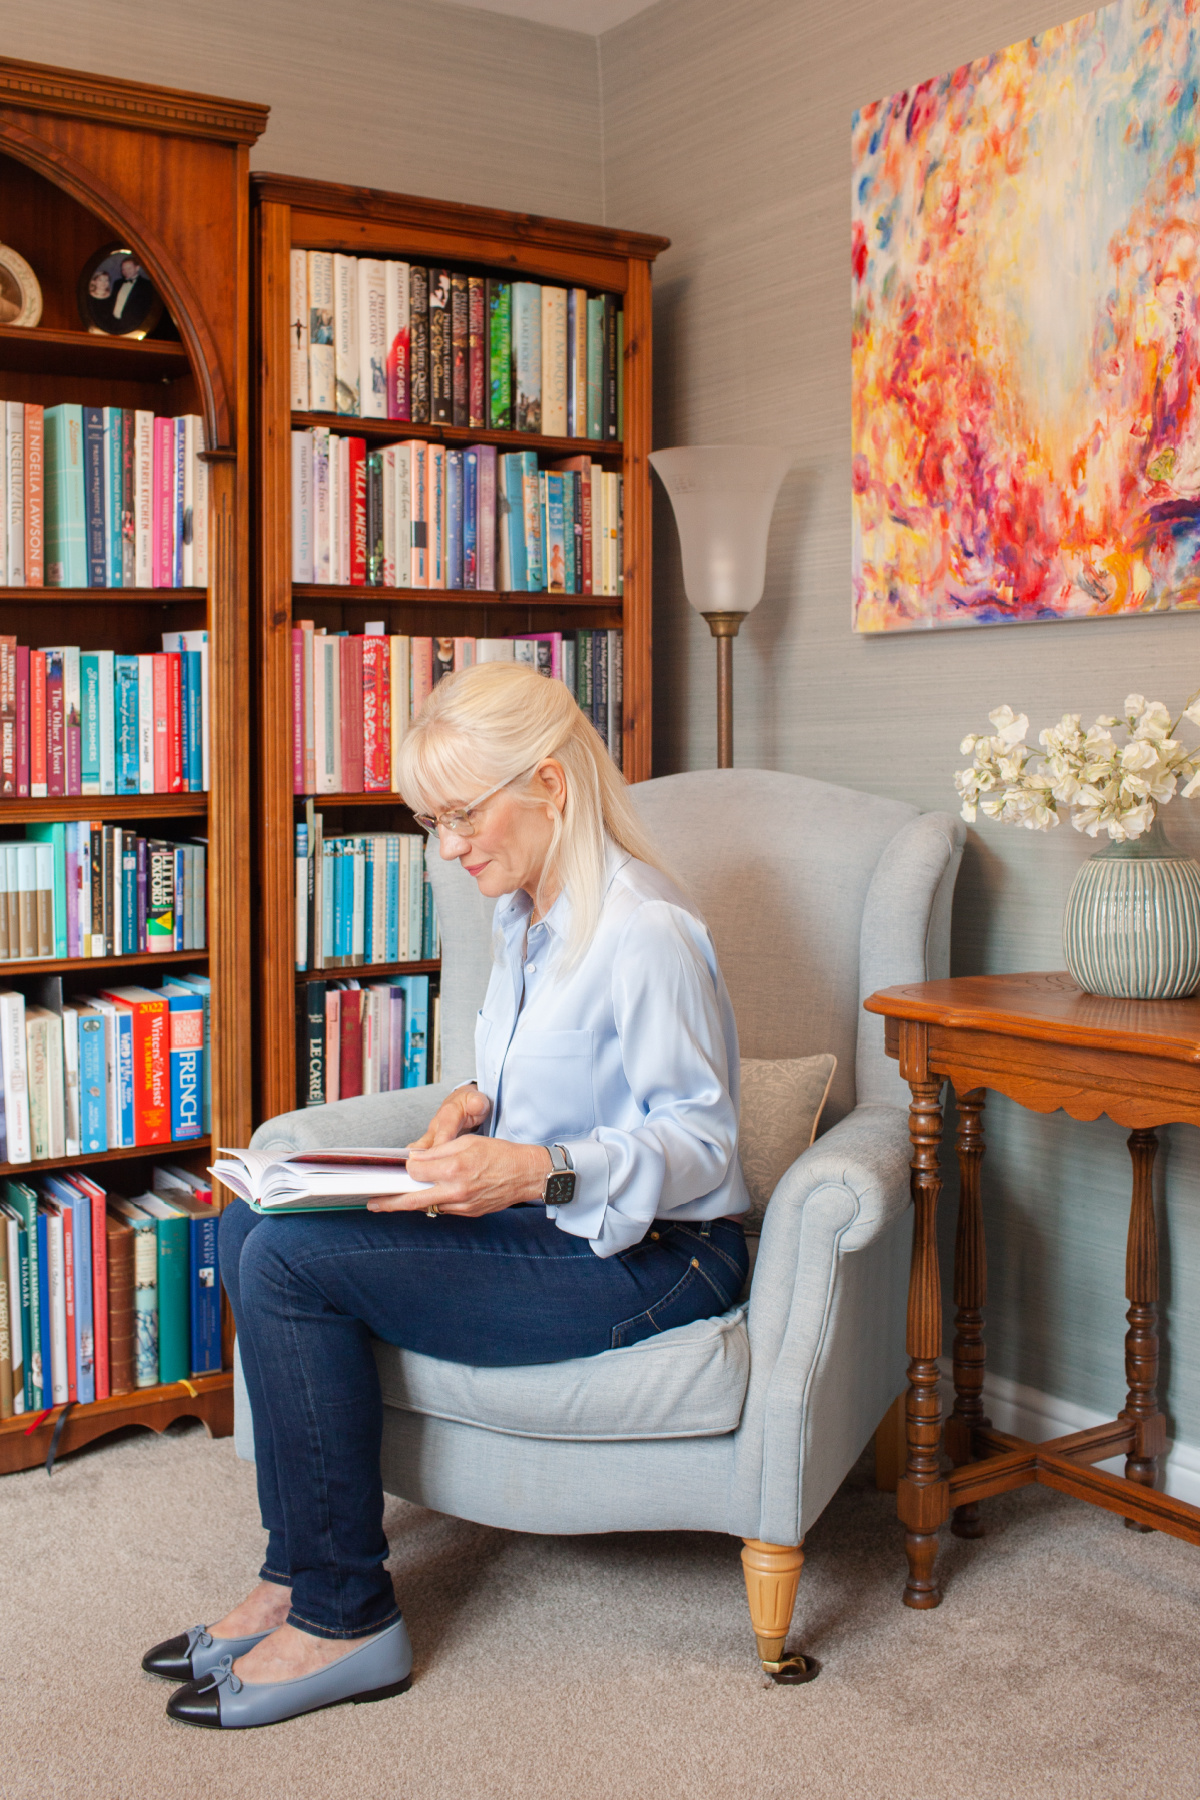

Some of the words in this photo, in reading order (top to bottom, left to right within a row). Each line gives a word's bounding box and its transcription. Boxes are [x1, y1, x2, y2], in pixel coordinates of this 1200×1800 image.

[314, 254, 323, 304] GREGORY
[341, 266, 349, 308] PHILIPPA
[342, 310, 350, 355] GREGORY
[368, 290, 378, 348] GREGORY
[556, 302, 564, 335] KATE
[397, 346, 405, 364] CITY
[555, 340, 565, 402] MORTON
[397, 367, 405, 378] OF
[397, 380, 405, 404] GIRLS
[141, 424, 150, 457] LITTLE
[30, 434, 41, 492] NIGELLA
[141, 460, 150, 486] PARIS
[301, 445, 309, 479] marian
[300, 480, 310, 504] keyes
[355, 460, 366, 498] VILLA
[141, 488, 150, 530] KITCHEN
[301, 508, 309, 540] Grown
[30, 498, 42, 560] LAWSON
[355, 503, 366, 564] AMERICA
[299, 542, 310, 560] Ups
[584, 649, 592, 671] Magic
[599, 649, 607, 671] Magic
[52, 688, 62, 708] The
[3, 722, 13, 757] RACHAEL
[52, 711, 62, 741] Other
[4, 759, 13, 774] RAY
[52, 744, 62, 774] Alcott
[152, 855, 162, 906] OXFORD
[162, 856, 174, 904] LITTLE
[140, 1002, 163, 1014] 2022
[152, 1016, 164, 1062] Writers'
[310, 1038, 322, 1058] LE
[14, 1059, 20, 1069] OF
[34, 1043, 43, 1084] GOWN
[121, 1059, 132, 1082] PLAY
[309, 1059, 323, 1100] CARRÉ
[153, 1069, 165, 1107] Artists'
[179, 1052, 197, 1127] FRENCH
[22, 1257, 31, 1307] NIAGARA
[0, 1336, 10, 1362] BOOK
